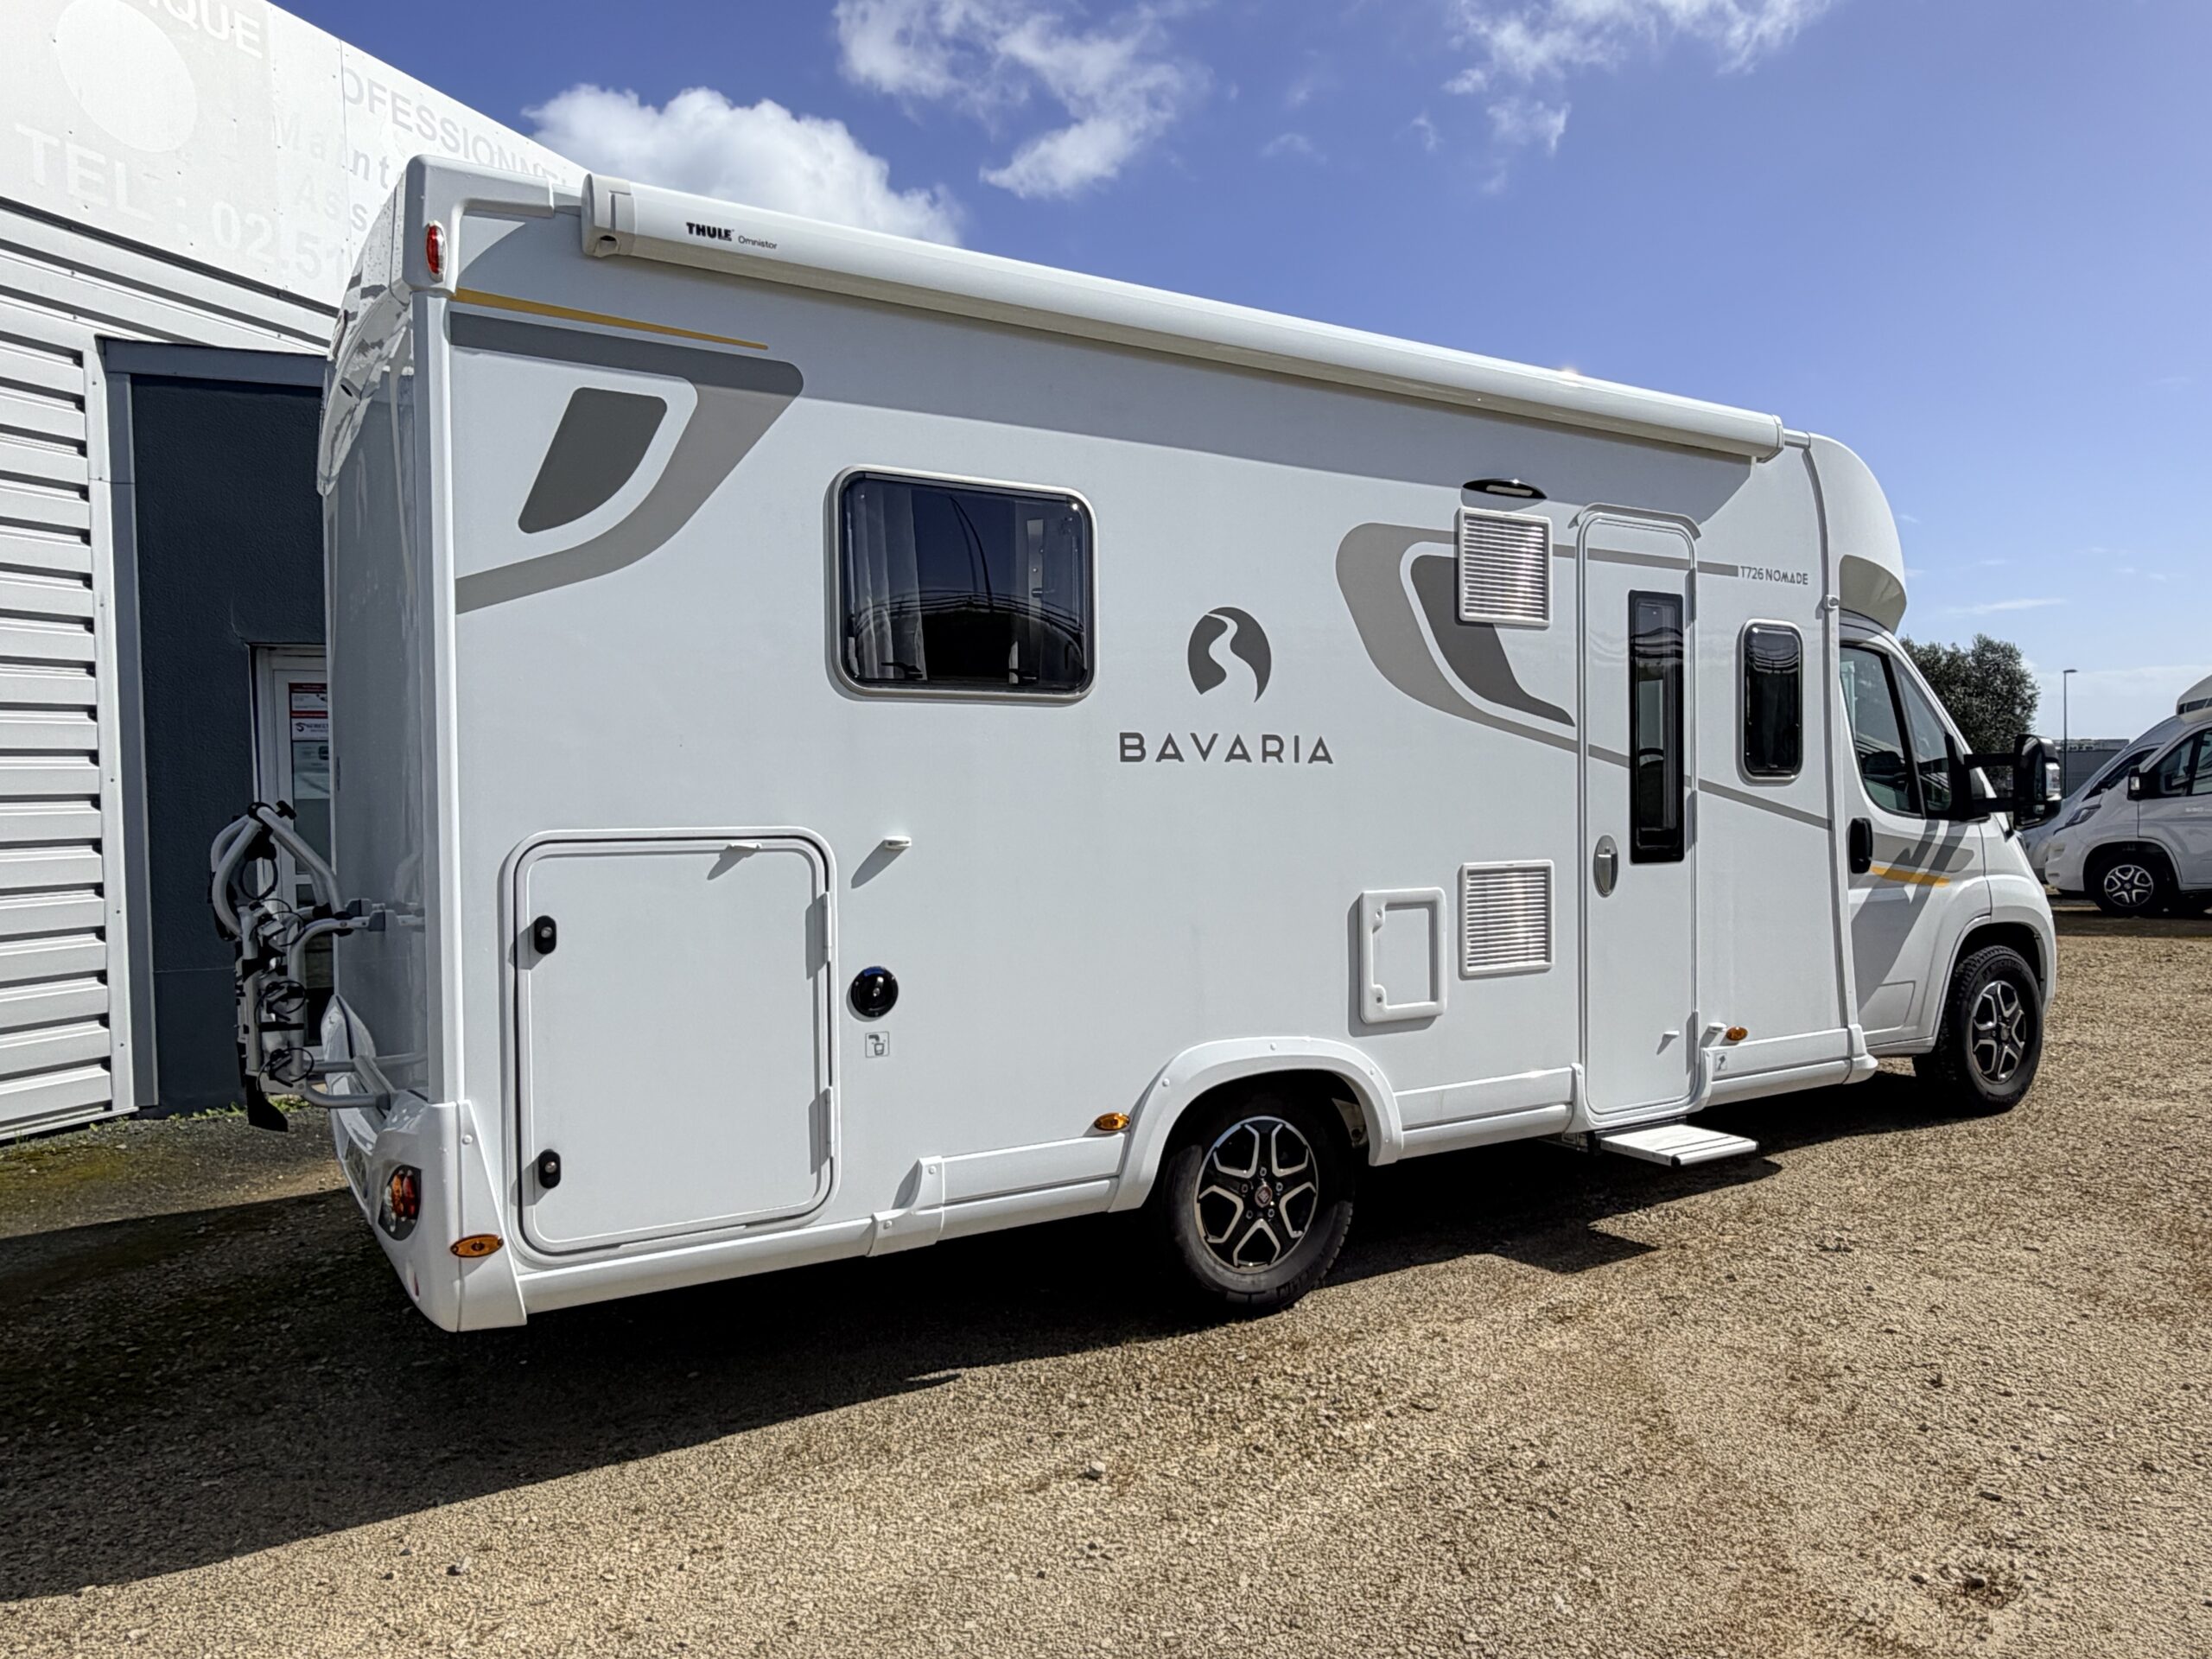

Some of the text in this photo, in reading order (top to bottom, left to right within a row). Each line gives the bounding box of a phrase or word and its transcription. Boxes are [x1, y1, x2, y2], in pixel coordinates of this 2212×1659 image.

[149, 0, 263, 60] QUE
[292, 173, 383, 234] Ass
[687, 222, 778, 250] THULE Omnistor
[1740, 566, 1808, 585] T726 NOMADE
[1119, 733, 1334, 764] BAVARIA
